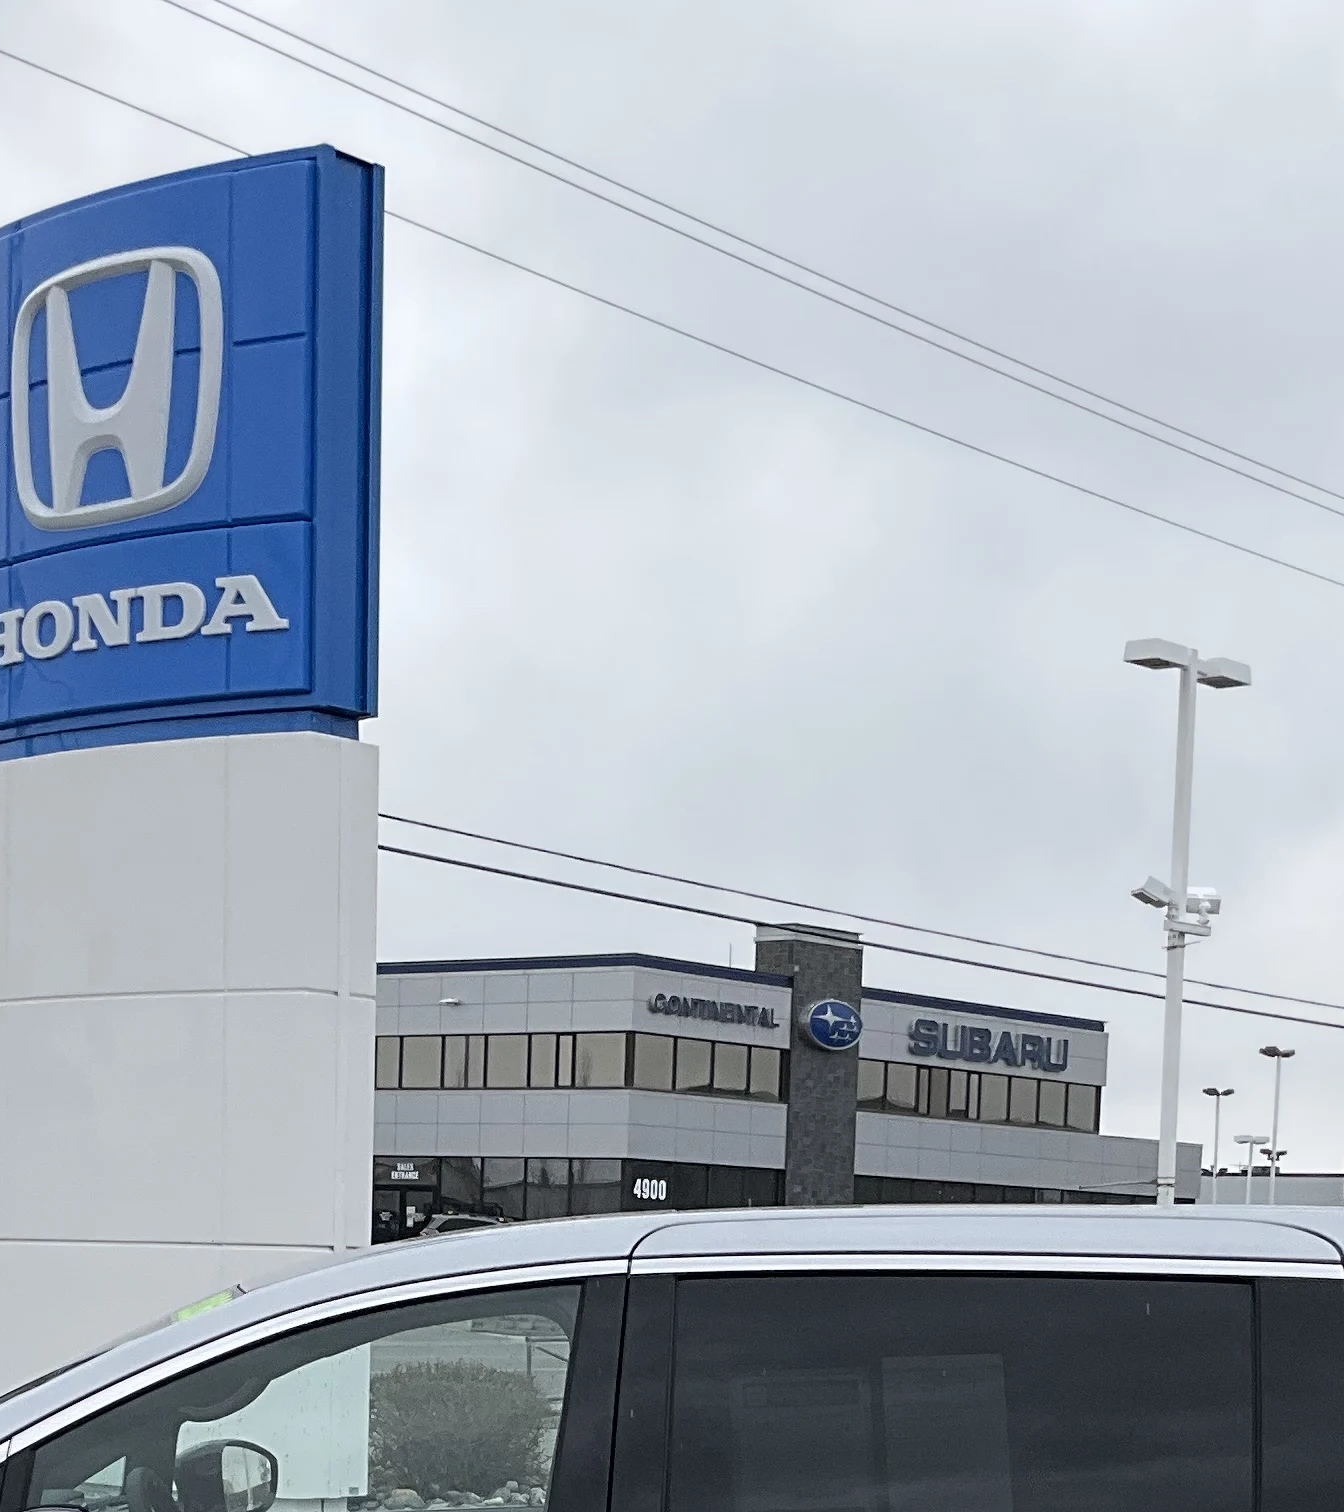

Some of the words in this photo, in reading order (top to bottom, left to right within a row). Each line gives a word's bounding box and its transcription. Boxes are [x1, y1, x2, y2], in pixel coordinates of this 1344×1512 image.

[647, 993, 780, 1028] CONTINENTAL
[908, 1018, 1069, 1072] SUBARU
[633, 1178, 667, 1201] 4900
